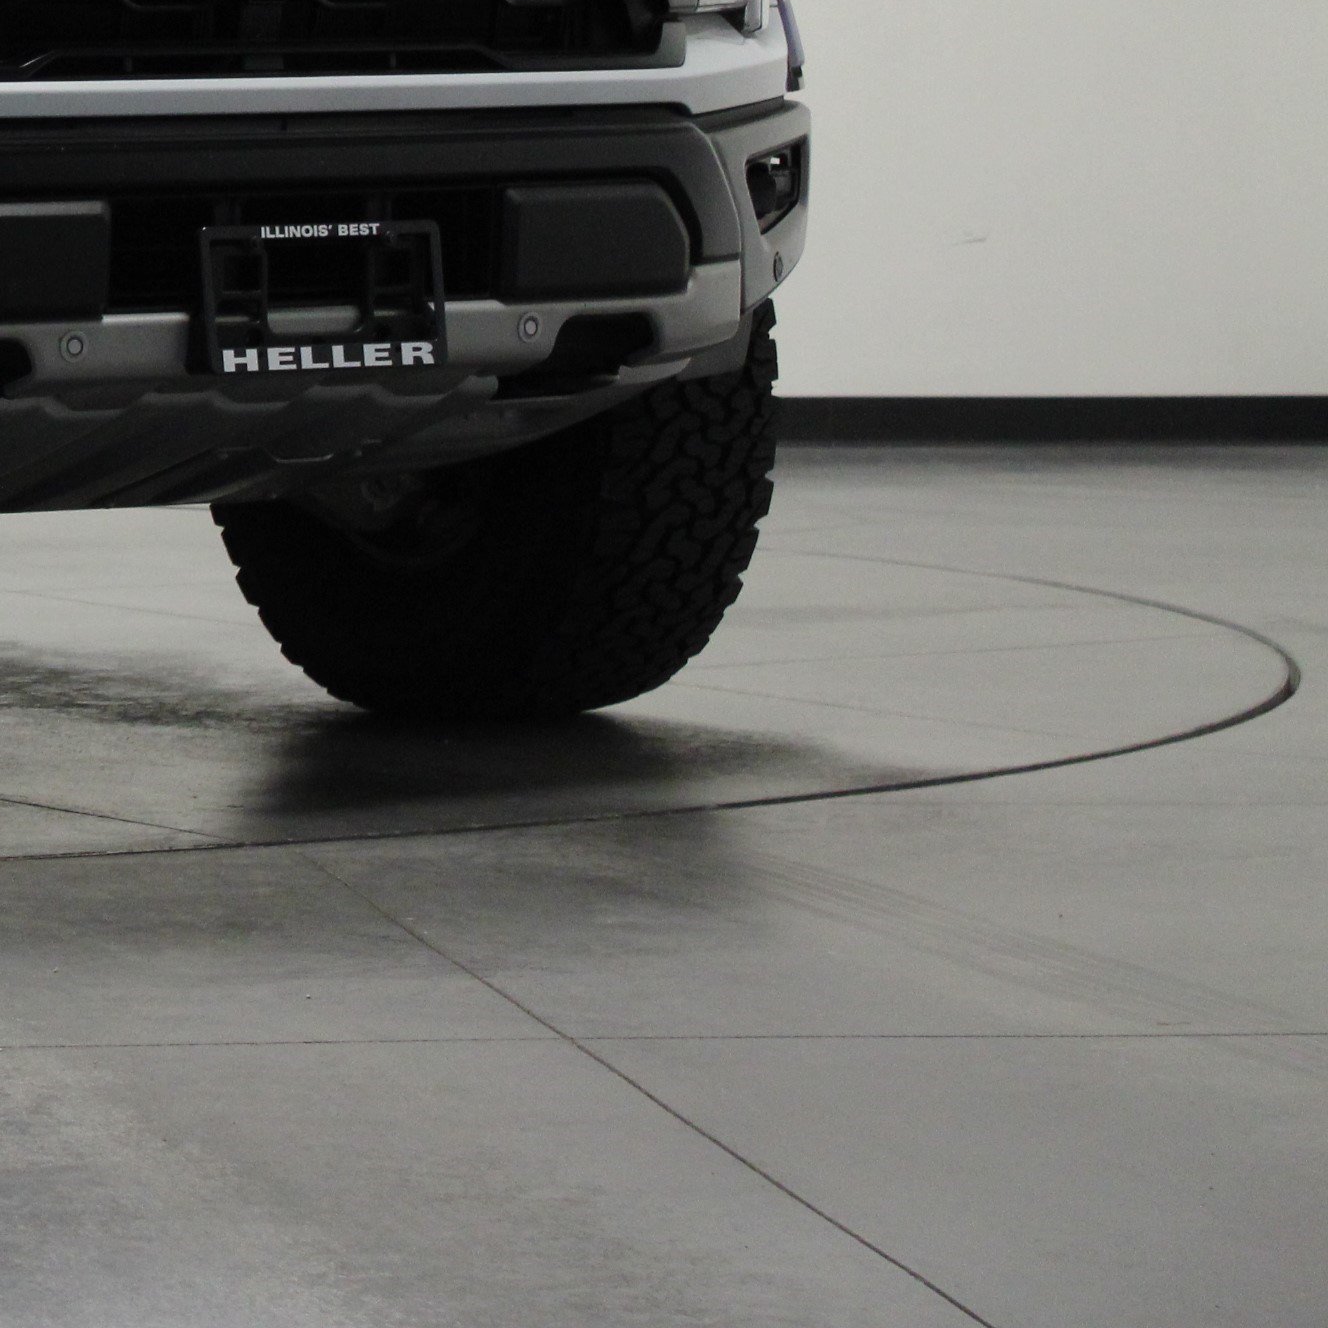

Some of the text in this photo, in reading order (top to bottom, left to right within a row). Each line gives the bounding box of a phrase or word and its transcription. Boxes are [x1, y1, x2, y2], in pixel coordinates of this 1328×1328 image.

[260, 223, 380, 239] ILLINOIS' BEST
[222, 341, 436, 373] HELLER
